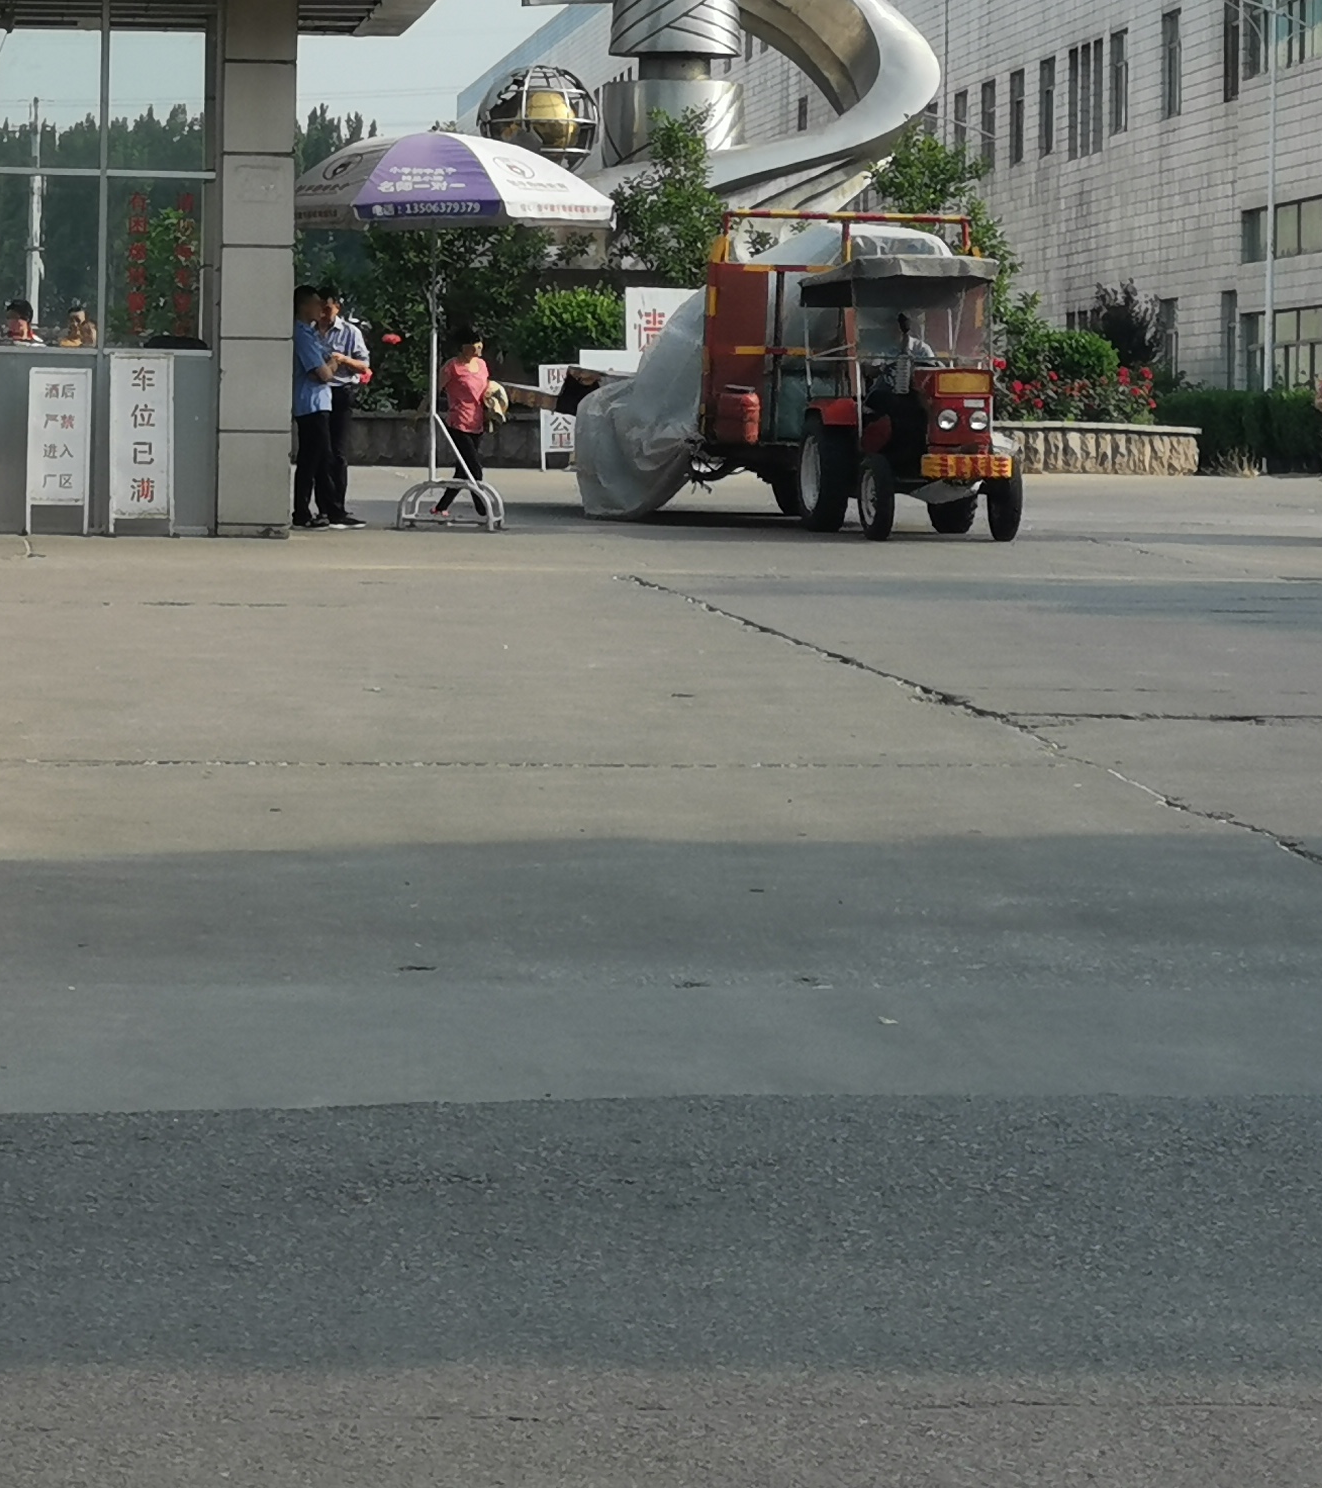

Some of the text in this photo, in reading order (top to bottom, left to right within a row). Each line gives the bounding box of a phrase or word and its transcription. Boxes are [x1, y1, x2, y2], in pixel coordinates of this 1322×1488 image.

[44, 383, 76, 400] 酒后
[43, 413, 76, 430] 严禁
[130, 366, 156, 503] 车位已满
[549, 416, 574, 449] 公里
[42, 443, 74, 460] 进入
[42, 473, 73, 489] 厂区
